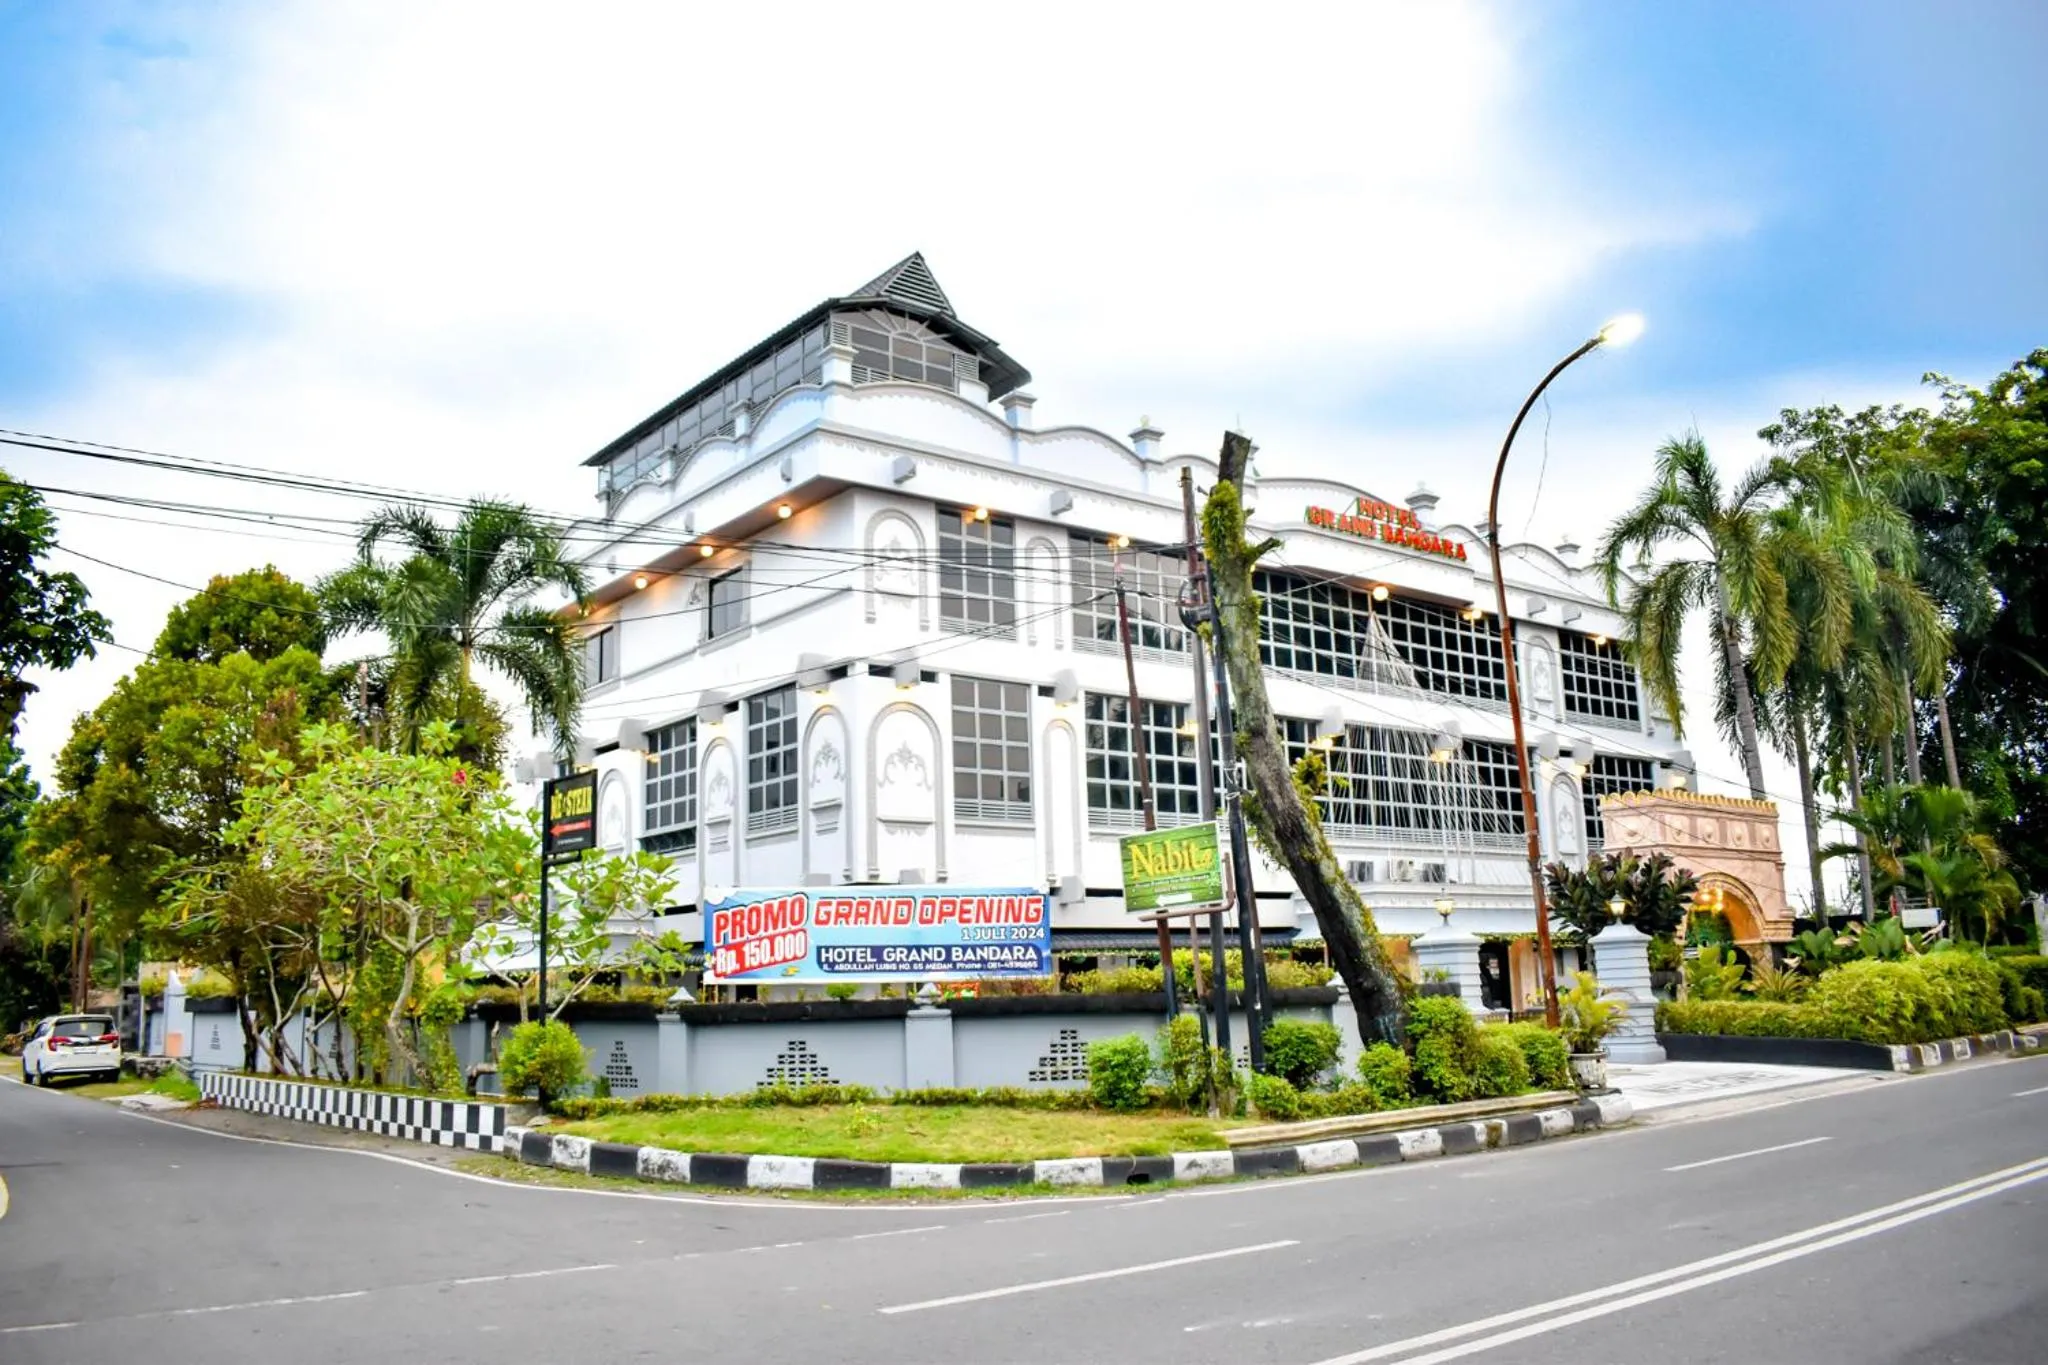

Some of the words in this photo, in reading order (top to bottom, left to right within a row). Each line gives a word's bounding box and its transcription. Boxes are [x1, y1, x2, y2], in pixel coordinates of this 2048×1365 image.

[1356, 496, 1421, 531] HOTEL
[1306, 505, 1377, 539] GRAND
[1380, 524, 1467, 562] BANDARA
[714, 894, 806, 945] PROMO
[814, 899, 913, 926] GRAND
[918, 897, 1043, 925] OPENING
[962, 928, 970, 940] 1
[974, 928, 1006, 940] JULI
[1011, 927, 1044, 939] 2024
[715, 948, 740, 974] Rp.
[743, 931, 805, 967] 150.000
[821, 947, 877, 963] HOTEL
[883, 947, 946, 962] GRAND
[952, 946, 1038, 961] BANDARA
